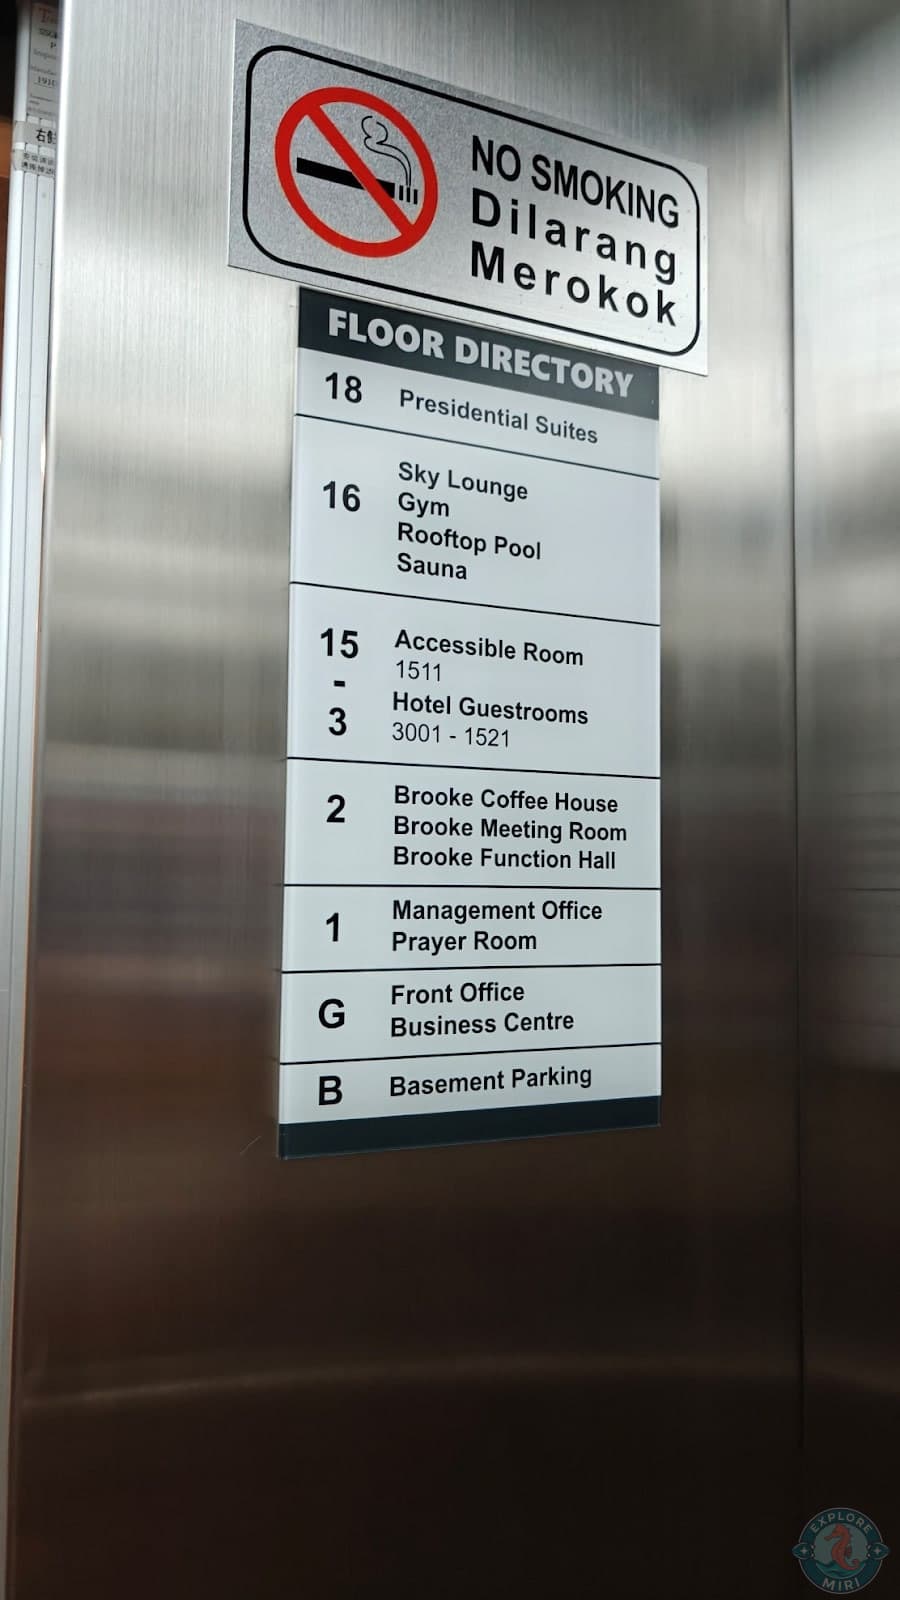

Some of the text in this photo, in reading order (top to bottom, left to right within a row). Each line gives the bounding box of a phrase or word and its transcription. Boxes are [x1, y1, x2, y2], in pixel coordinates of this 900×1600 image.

[472, 135, 678, 228] NO SMOKING
[472, 185, 678, 285] Dilarang
[470, 241, 675, 327] Merokok
[329, 309, 633, 397] FLOOR DIRECTORY
[326, 372, 597, 443] 18 Presidential Suites
[324, 481, 360, 512] 16
[399, 462, 527, 502] Sky Lounge
[399, 492, 449, 518] Gym
[398, 522, 540, 559] Rooftop Pool
[398, 553, 466, 579] Sauna
[321, 628, 358, 658] 15
[395, 630, 583, 665] Accessible Room
[397, 660, 440, 681] 1511
[329, 708, 346, 735] 3
[394, 692, 588, 724] Hotel Guestrooms
[393, 722, 439, 743] 3001
[466, 728, 508, 747] 1521
[327, 795, 345, 823] 2
[395, 785, 618, 812] Brooke Coffee House
[395, 816, 626, 843] Brooke Meeting Room
[394, 846, 615, 869] Brooke Function Hall
[393, 900, 602, 924] Management Office
[326, 913, 338, 942] 1
[393, 931, 536, 956] Prayer Room
[392, 982, 524, 1004] Front Office
[319, 999, 344, 1028] G
[392, 1012, 574, 1037] Business Centre
[319, 1066, 591, 1105] B Basement Parking
